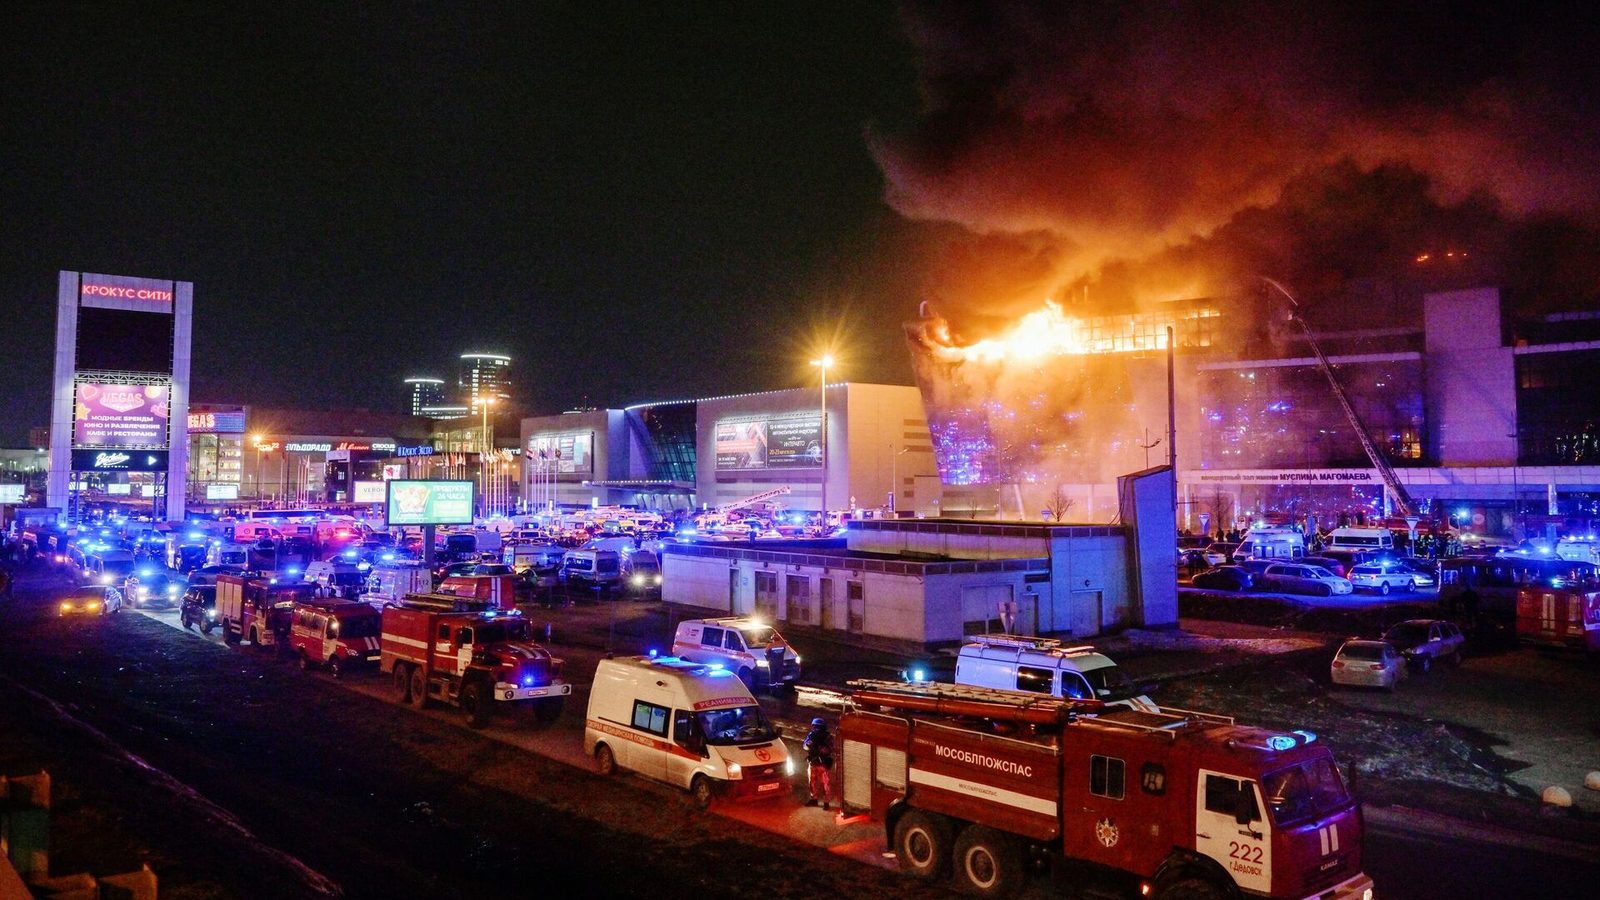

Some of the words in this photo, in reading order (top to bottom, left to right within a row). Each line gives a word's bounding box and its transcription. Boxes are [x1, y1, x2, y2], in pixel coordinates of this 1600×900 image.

[82, 285, 135, 298] КРОКУС
[137, 289, 172, 301] СИТИ
[102, 392, 143, 403] VEGAS
[284, 443, 332, 452] ЭЛЬДОРАДО
[1279, 473, 1318, 481] МУСЛИМА
[1319, 473, 1372, 481] МАГОМАЕВА
[935, 744, 1033, 778] МОСОБЛПОЖСПАС
[1229, 841, 1263, 865] 222
